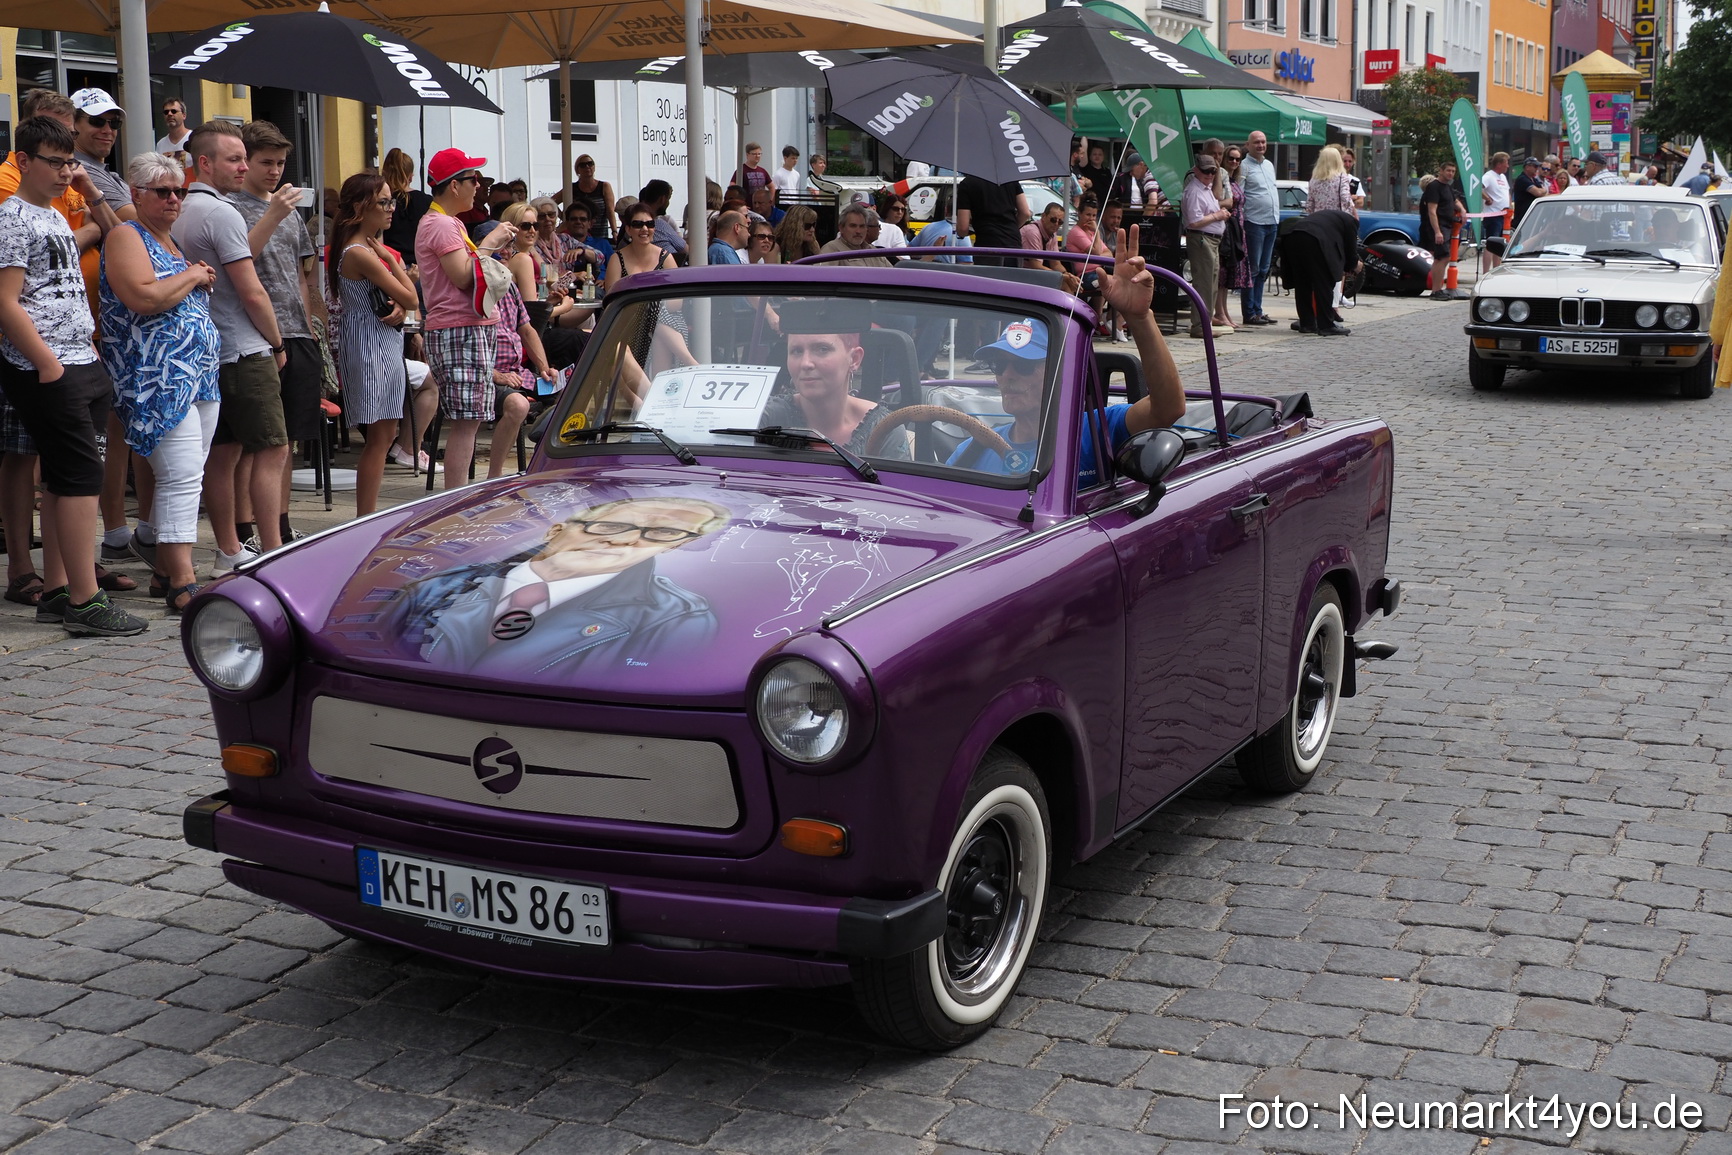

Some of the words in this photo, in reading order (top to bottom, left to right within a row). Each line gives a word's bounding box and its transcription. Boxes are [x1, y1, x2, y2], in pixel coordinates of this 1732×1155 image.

[1635, 0, 1654, 99] HOTEL
[1369, 60, 1393, 71] WITT
[656, 98, 671, 119] 30
[642, 125, 667, 146] Bang
[670, 127, 677, 142] &
[1300, 119, 1313, 136] DEKRA
[651, 149, 660, 166] in
[1015, 333, 1022, 341] 5
[1546, 339, 1564, 352] AS
[1572, 340, 1580, 353] E
[1584, 341, 1617, 354] 525H
[701, 381, 750, 401] 377
[365, 882, 374, 895] D
[381, 859, 447, 913] KEH
[471, 876, 518, 925] MS
[529, 885, 575, 935] 86
[582, 893, 599, 907] 03
[457, 926, 494, 940] Labsward
[584, 924, 602, 938] 10
